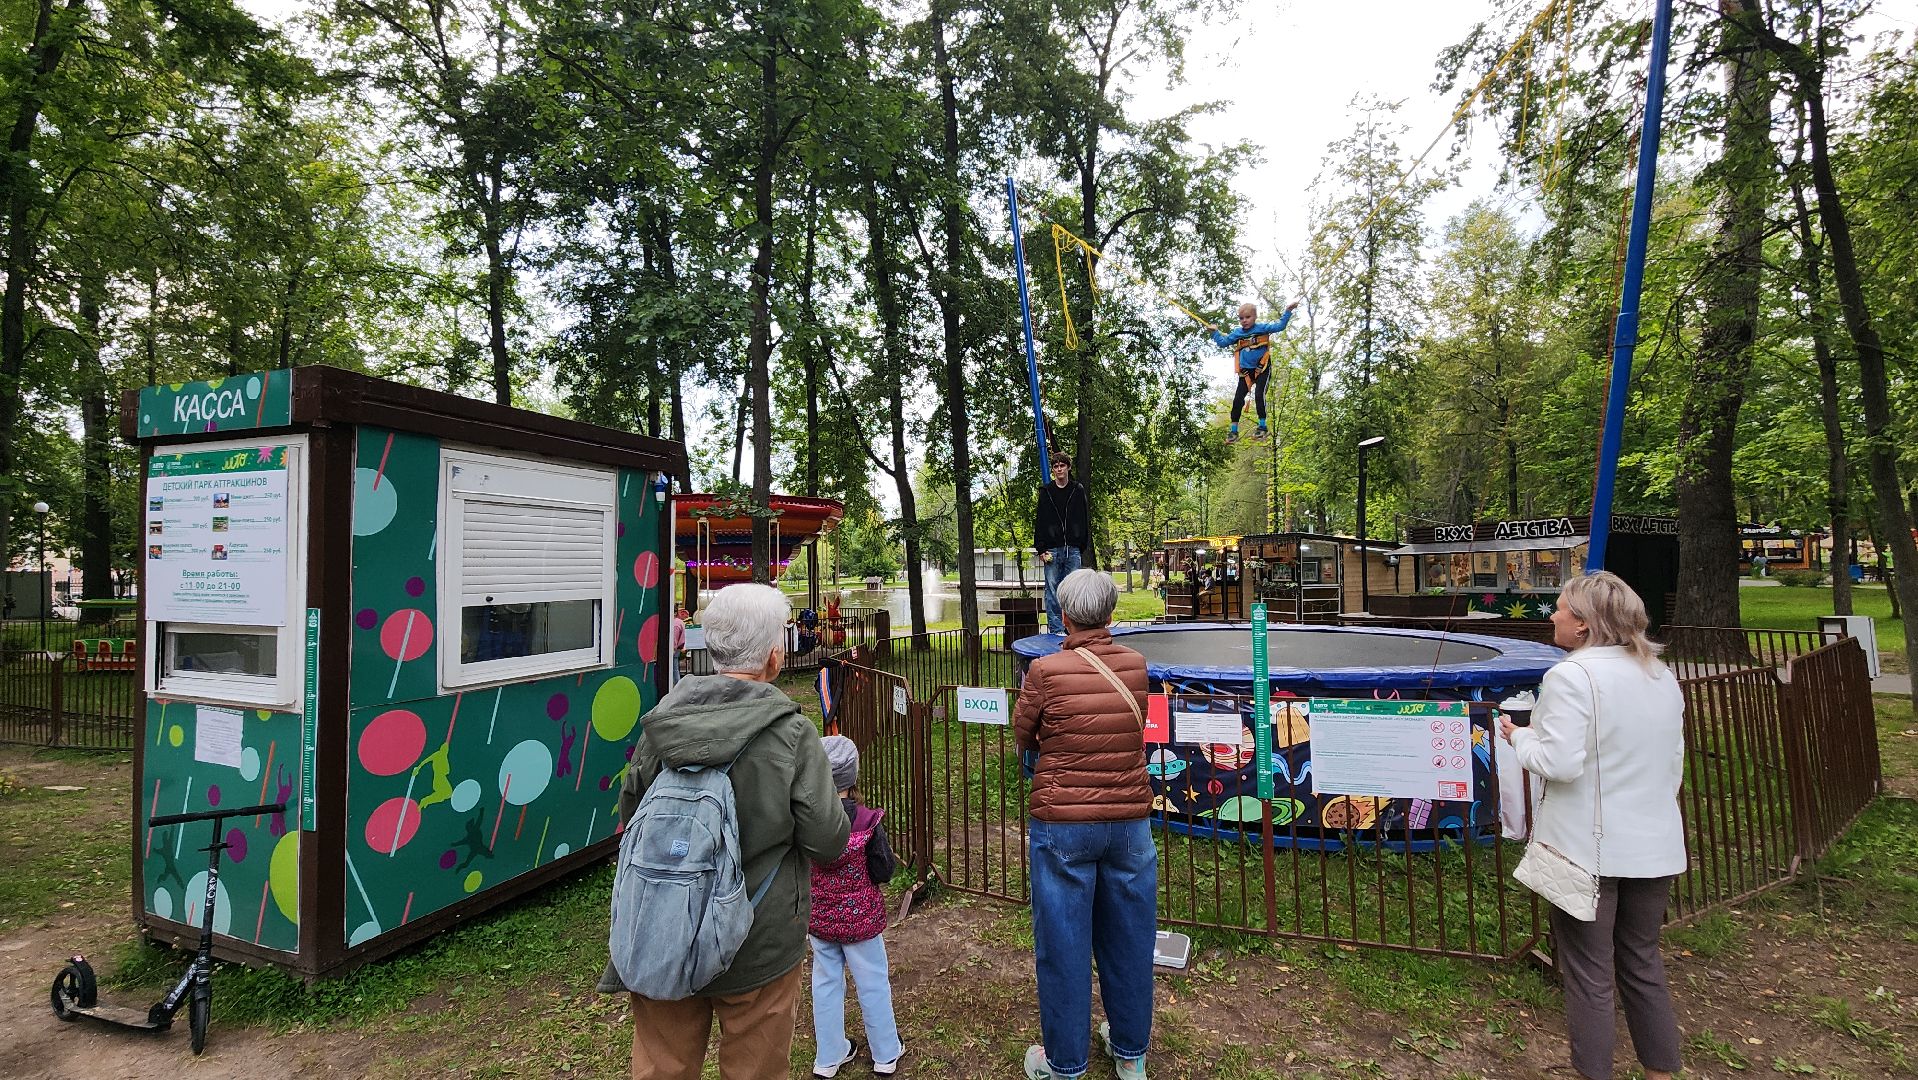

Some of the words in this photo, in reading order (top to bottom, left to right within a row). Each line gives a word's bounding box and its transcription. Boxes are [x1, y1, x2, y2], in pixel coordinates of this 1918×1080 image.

[173, 389, 246, 423] КАССА
[162, 480, 193, 491] ДЕТСКИЙ
[194, 479, 212, 489] ПАРК
[1435, 525, 1473, 541] ВКУС
[1495, 518, 1574, 540] ДЕТСТВА
[1612, 515, 1639, 533] ВКУС
[182, 569, 205, 578] Время
[206, 570, 239, 579] работы:
[218, 582, 241, 590] 21-00
[964, 698, 999, 712] ВХОД
